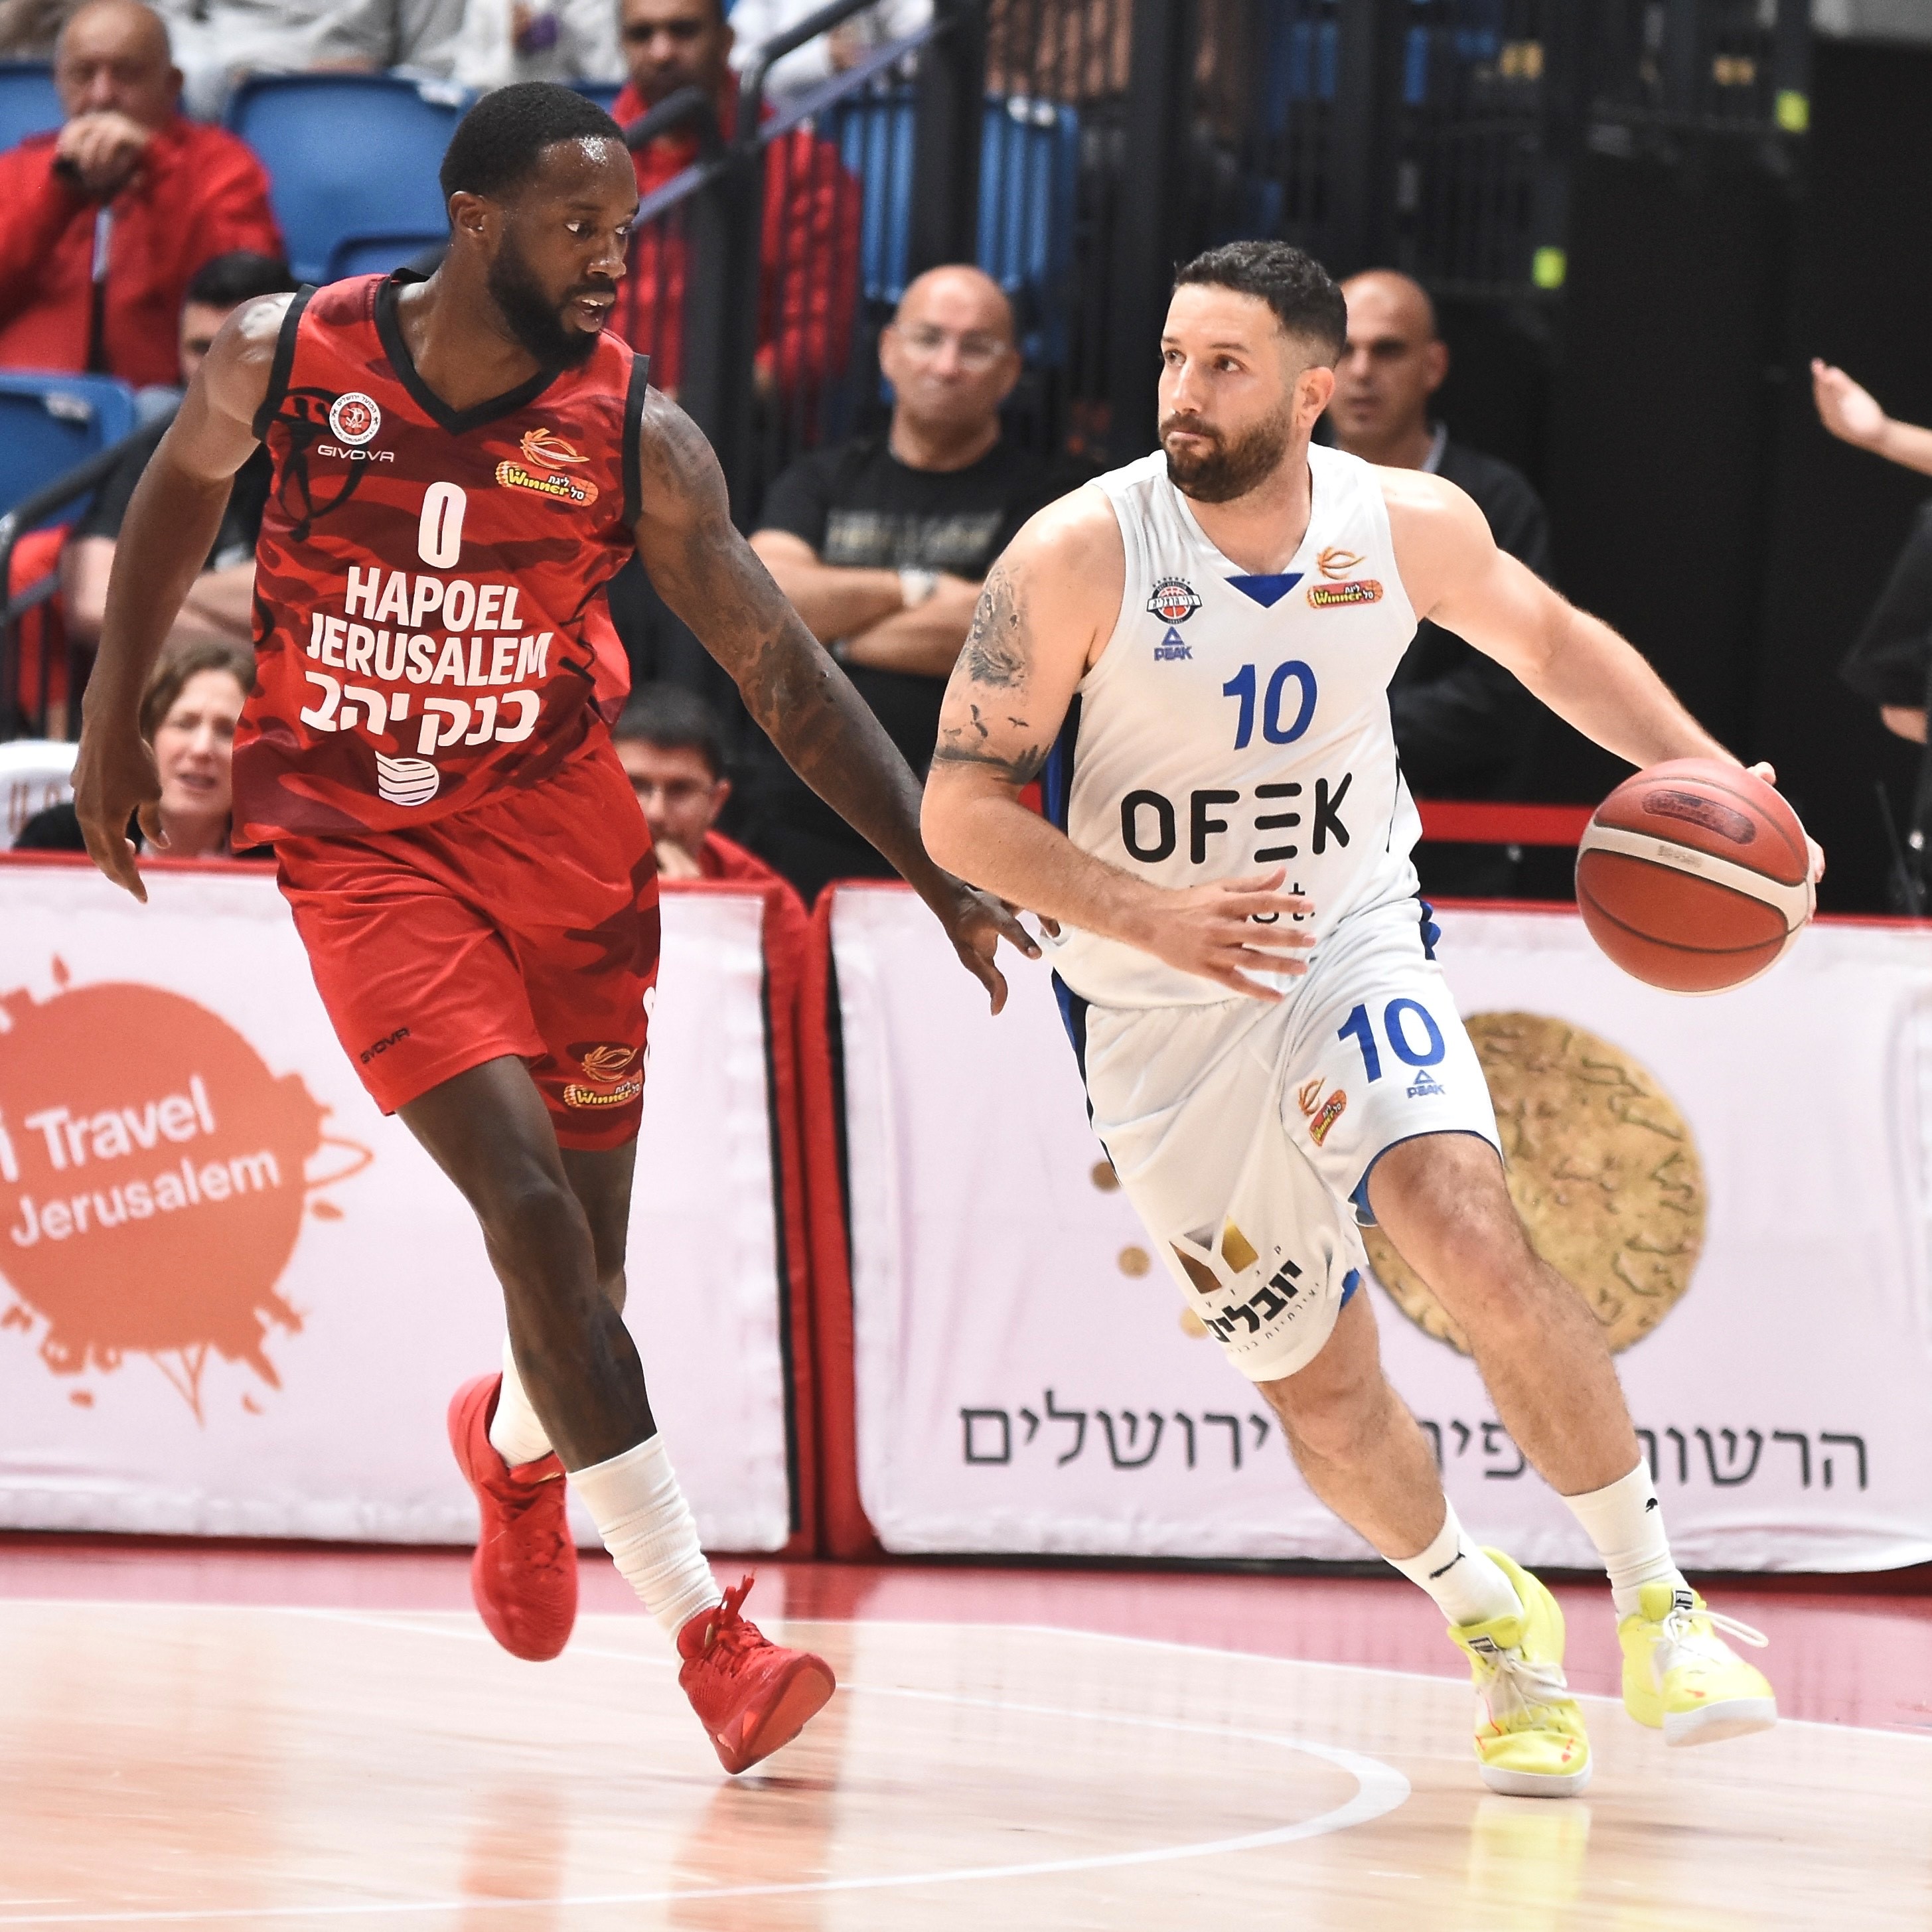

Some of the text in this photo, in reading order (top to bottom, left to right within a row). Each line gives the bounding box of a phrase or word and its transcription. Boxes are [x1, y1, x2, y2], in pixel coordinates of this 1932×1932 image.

[317, 445, 395, 463] GIVOVA
[508, 468, 585, 500] Winner סל
[548, 475, 570, 487] ליגת
[417, 481, 467, 569] 0
[344, 565, 523, 632] HAPOEL
[1315, 591, 1363, 604] Winner
[306, 612, 554, 686] JERUSALEM
[1153, 646, 1193, 661] PEAK
[299, 670, 541, 755] בנק יהב
[1223, 659, 1318, 751] 10
[1120, 772, 1353, 864] OFEK
[1337, 998, 1446, 1084] 10
[24, 1072, 216, 1171] Travel
[576, 1089, 632, 1104] Winner
[1406, 1084, 1446, 1098] PEAK
[10, 1149, 282, 1248] Jerusalem
[959, 1388, 1271, 1471] ירושלים
